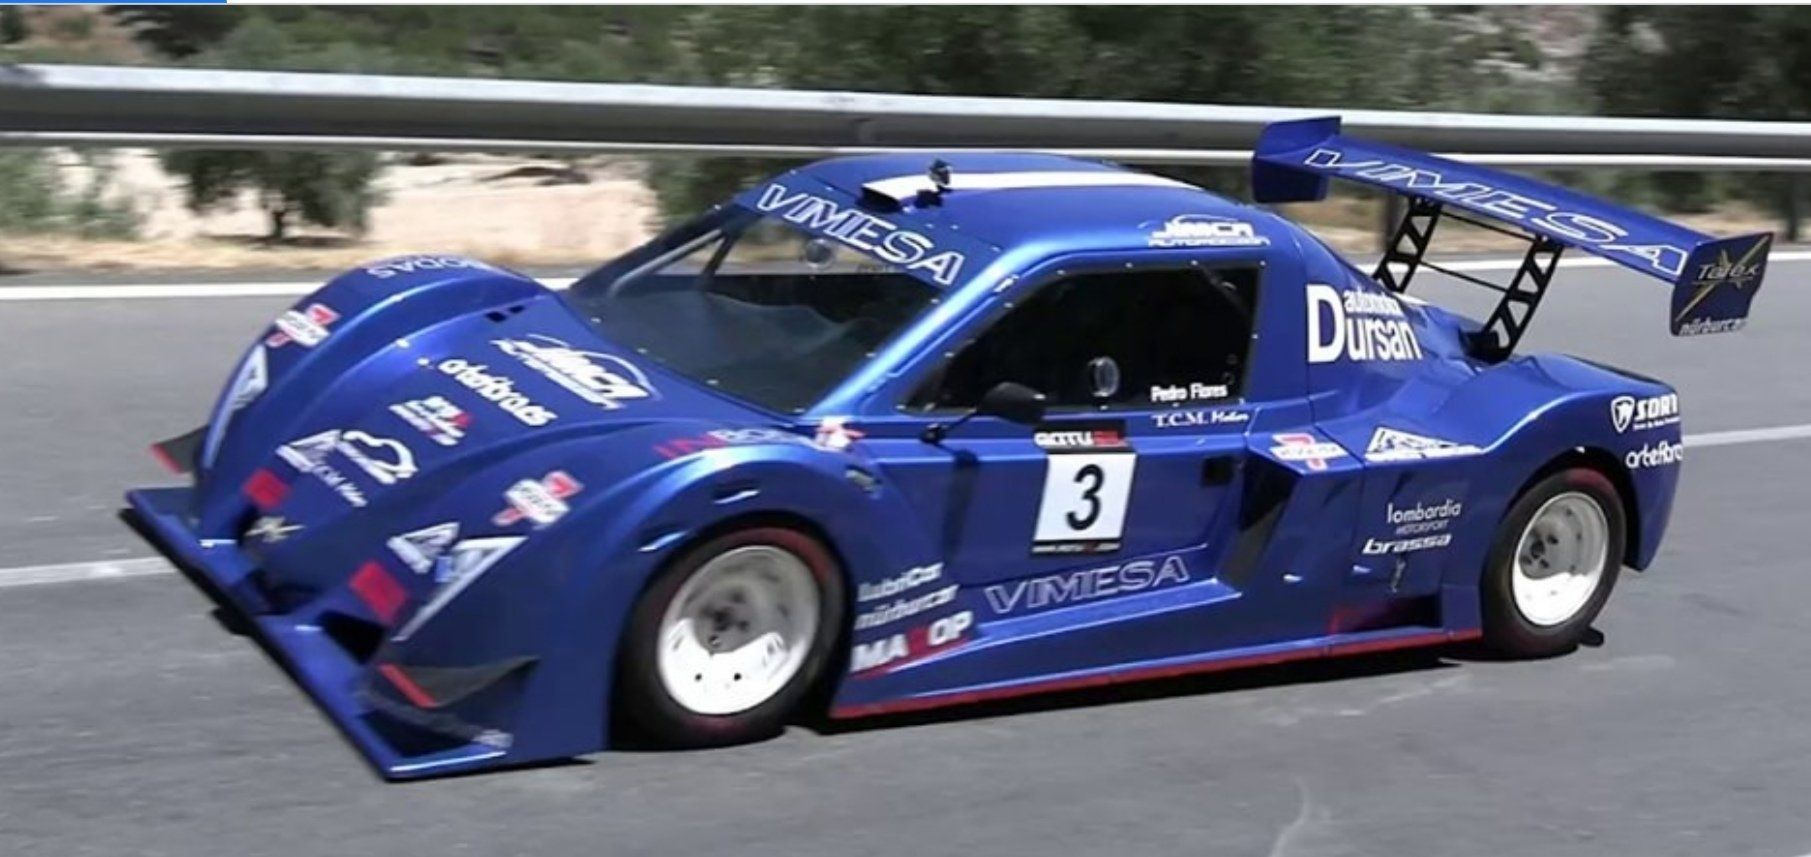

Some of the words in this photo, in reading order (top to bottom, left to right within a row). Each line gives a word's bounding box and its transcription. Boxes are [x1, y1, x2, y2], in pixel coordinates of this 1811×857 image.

[757, 183, 965, 286] VIMESA
[1304, 149, 1689, 276] VIMESA
[1306, 284, 1422, 363] Dursan
[1151, 385, 1188, 402] Pedro
[1189, 382, 1228, 399] Flores
[1065, 463, 1105, 532] 3
[1386, 499, 1463, 524] lombardia
[1362, 533, 1452, 555] brassa
[985, 555, 1191, 615] VIMESA
